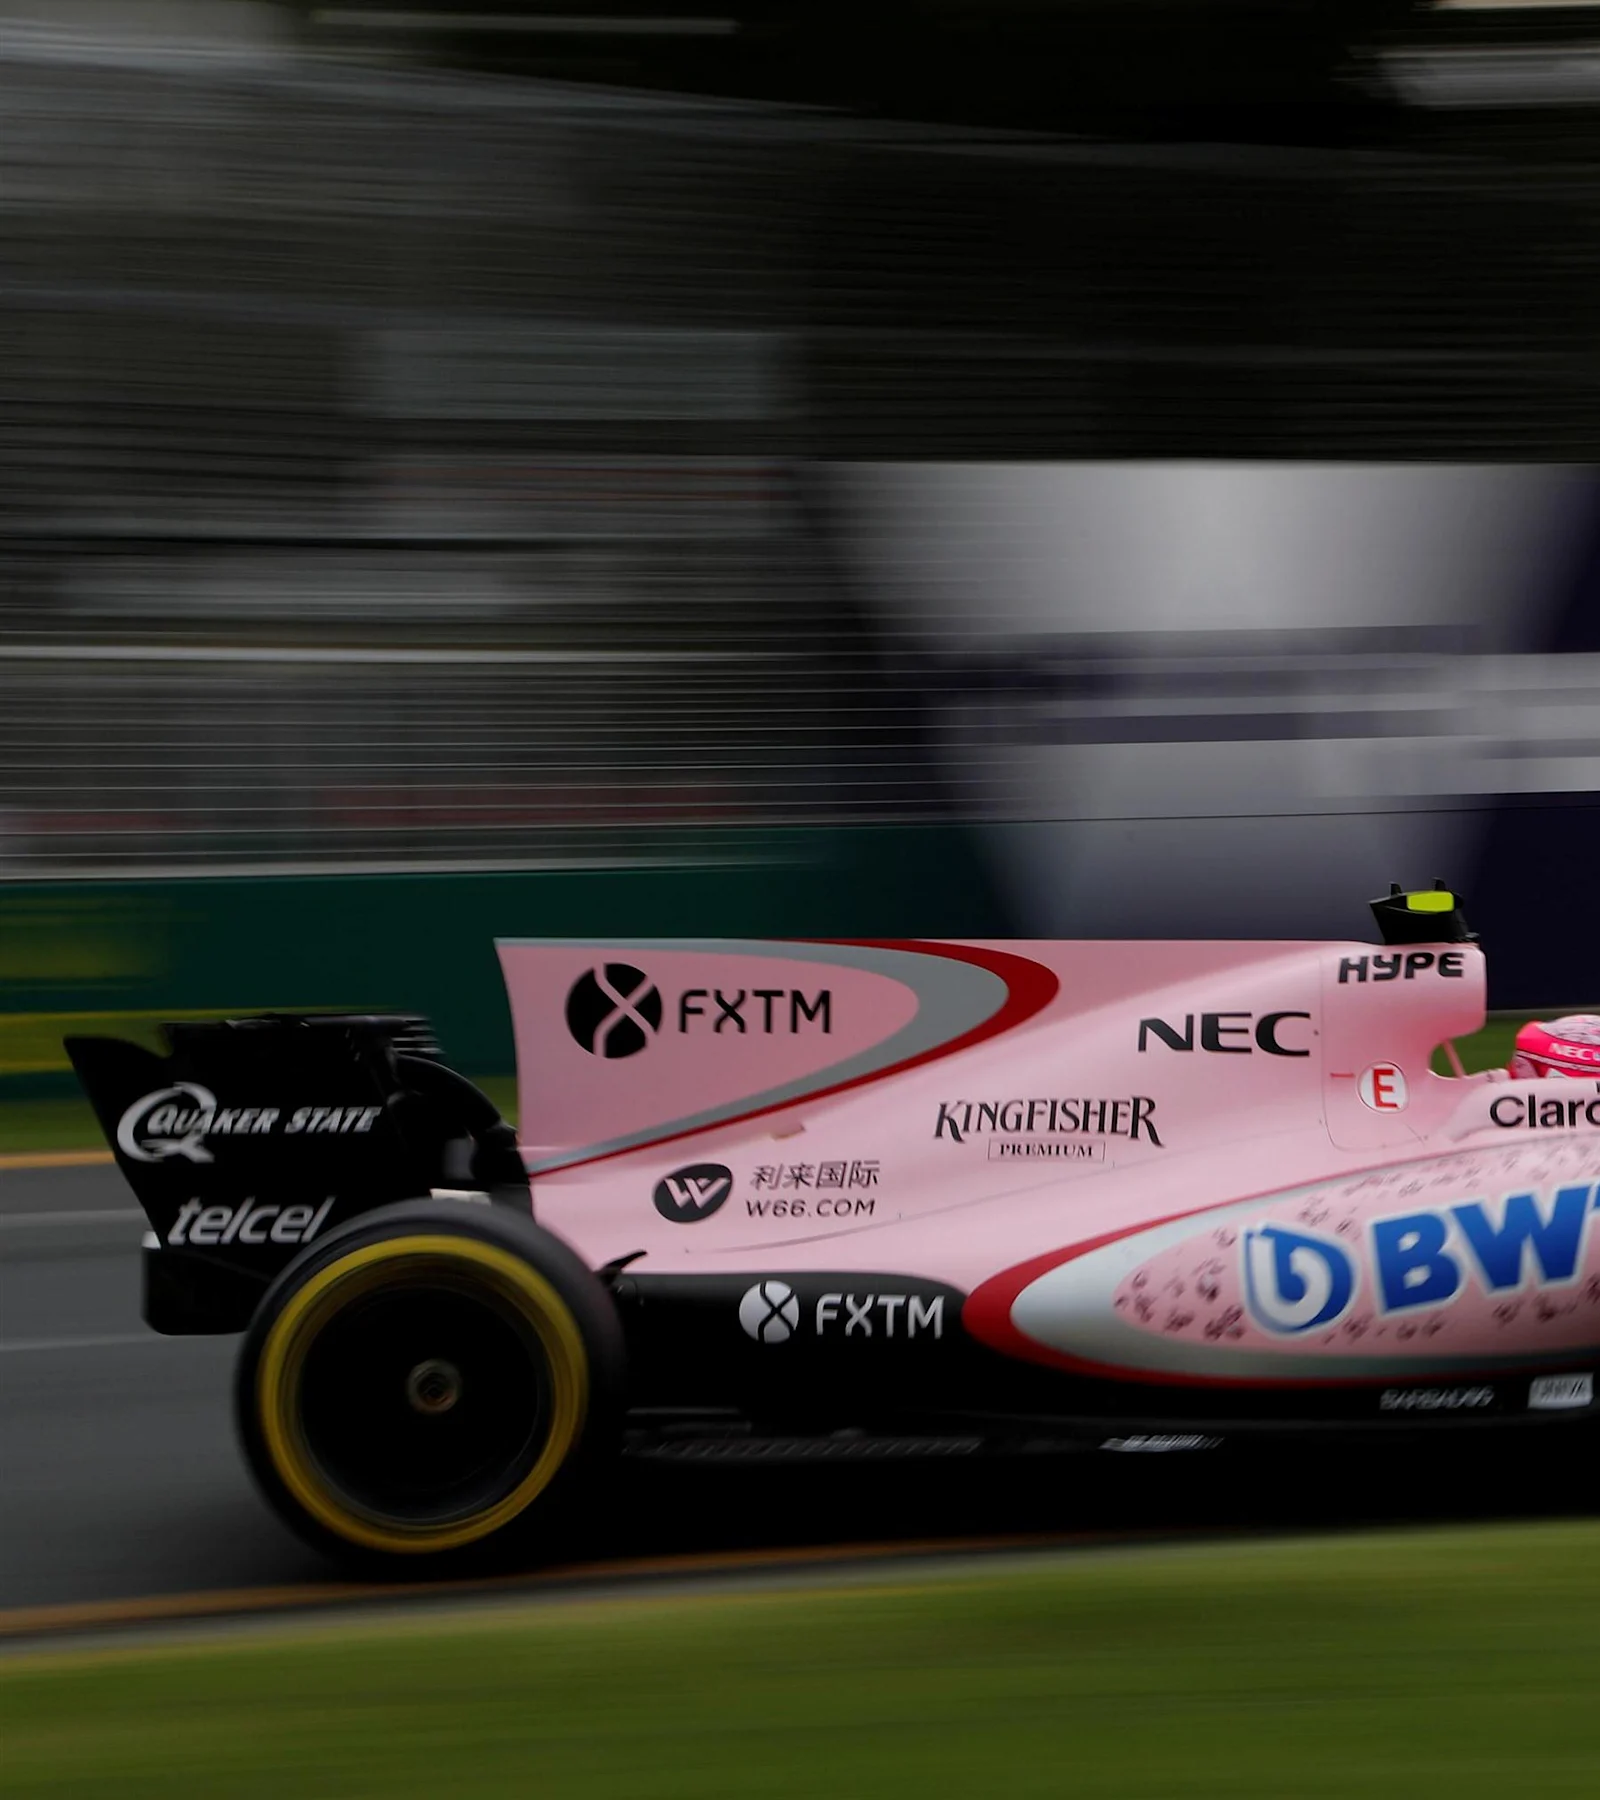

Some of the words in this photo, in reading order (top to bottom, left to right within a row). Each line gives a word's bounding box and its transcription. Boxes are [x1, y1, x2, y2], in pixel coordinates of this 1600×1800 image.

[1338, 952, 1465, 984] HYPE
[678, 989, 832, 1034] FXTM
[1138, 1011, 1311, 1057] NEC
[1549, 1043, 1594, 1060] NEC
[1371, 1067, 1398, 1109] E
[147, 1105, 275, 1135] QUAKER
[284, 1106, 382, 1134] STATE
[934, 1096, 1165, 1148] KINGFISHER
[999, 1142, 1094, 1159] PREMIUM
[750, 1160, 881, 1191] 利来国际
[167, 1197, 336, 1245] telcel
[745, 1198, 877, 1217] W66.COM
[815, 1293, 945, 1340] FXTM
